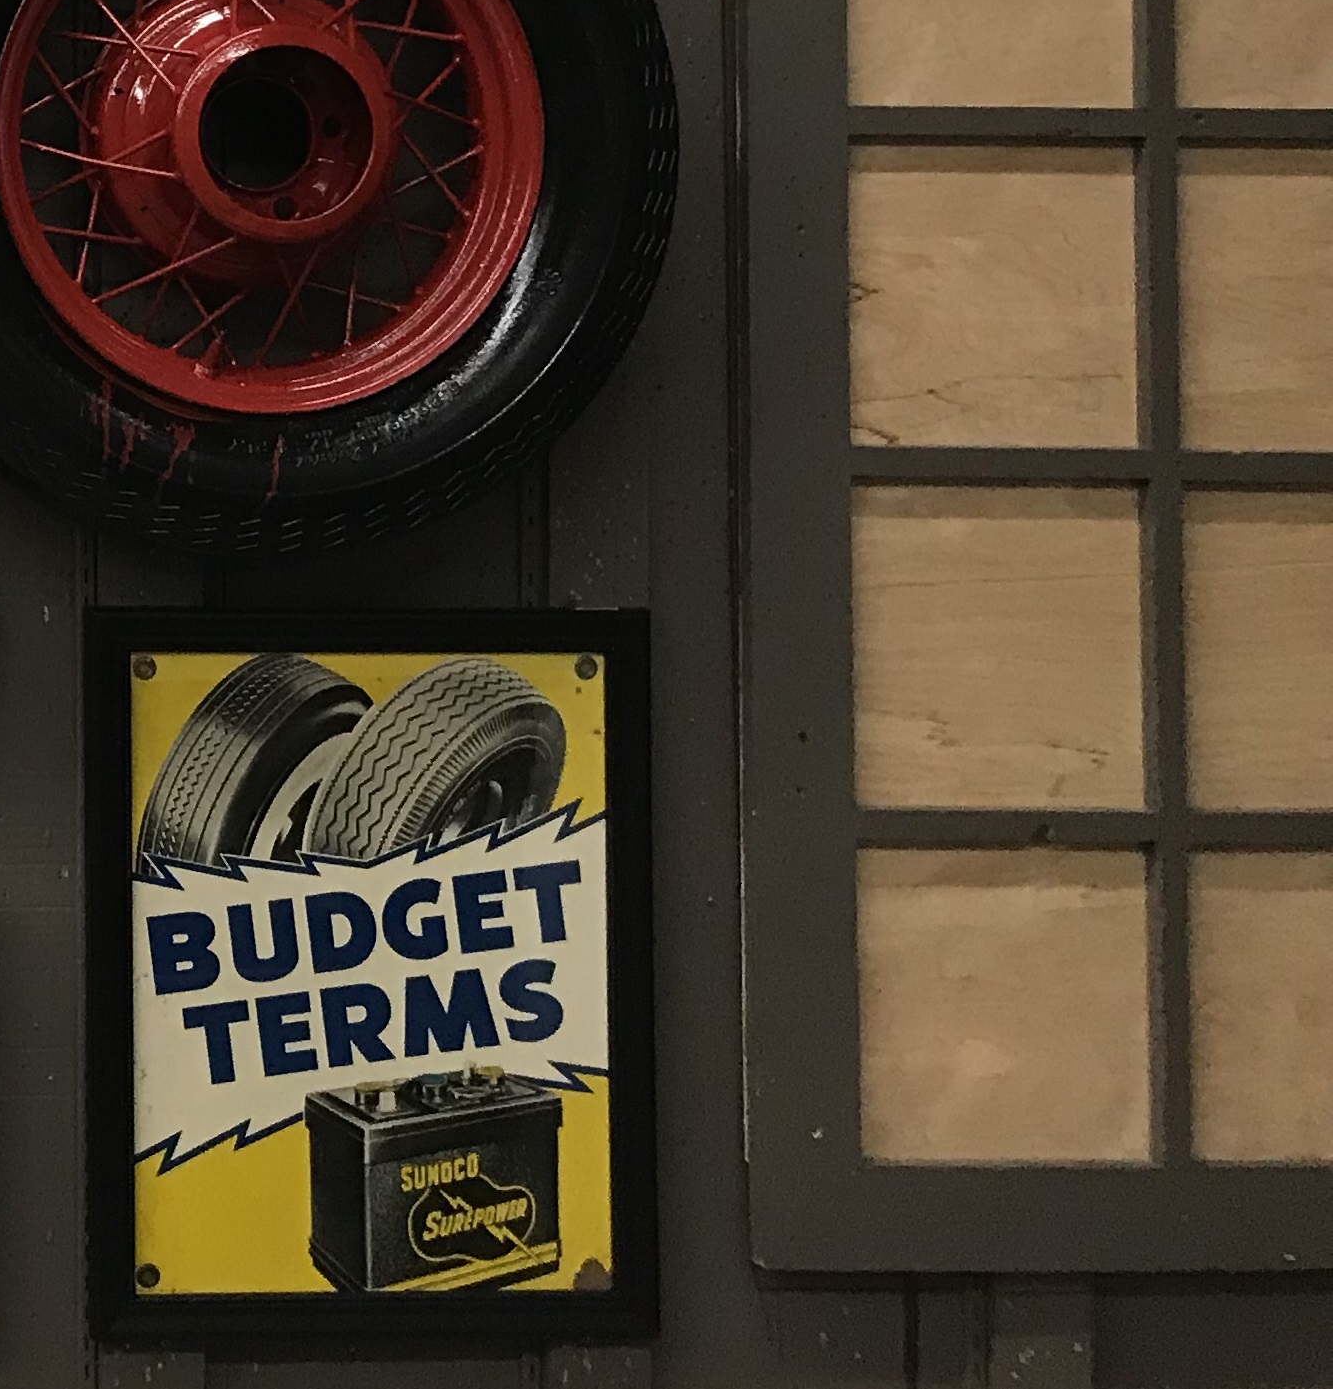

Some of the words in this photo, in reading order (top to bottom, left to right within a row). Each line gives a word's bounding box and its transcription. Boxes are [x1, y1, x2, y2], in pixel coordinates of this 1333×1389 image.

[146, 859, 582, 996] BUDGET
[182, 959, 565, 1085] TERMS
[400, 1152, 480, 1193] SUNOCO
